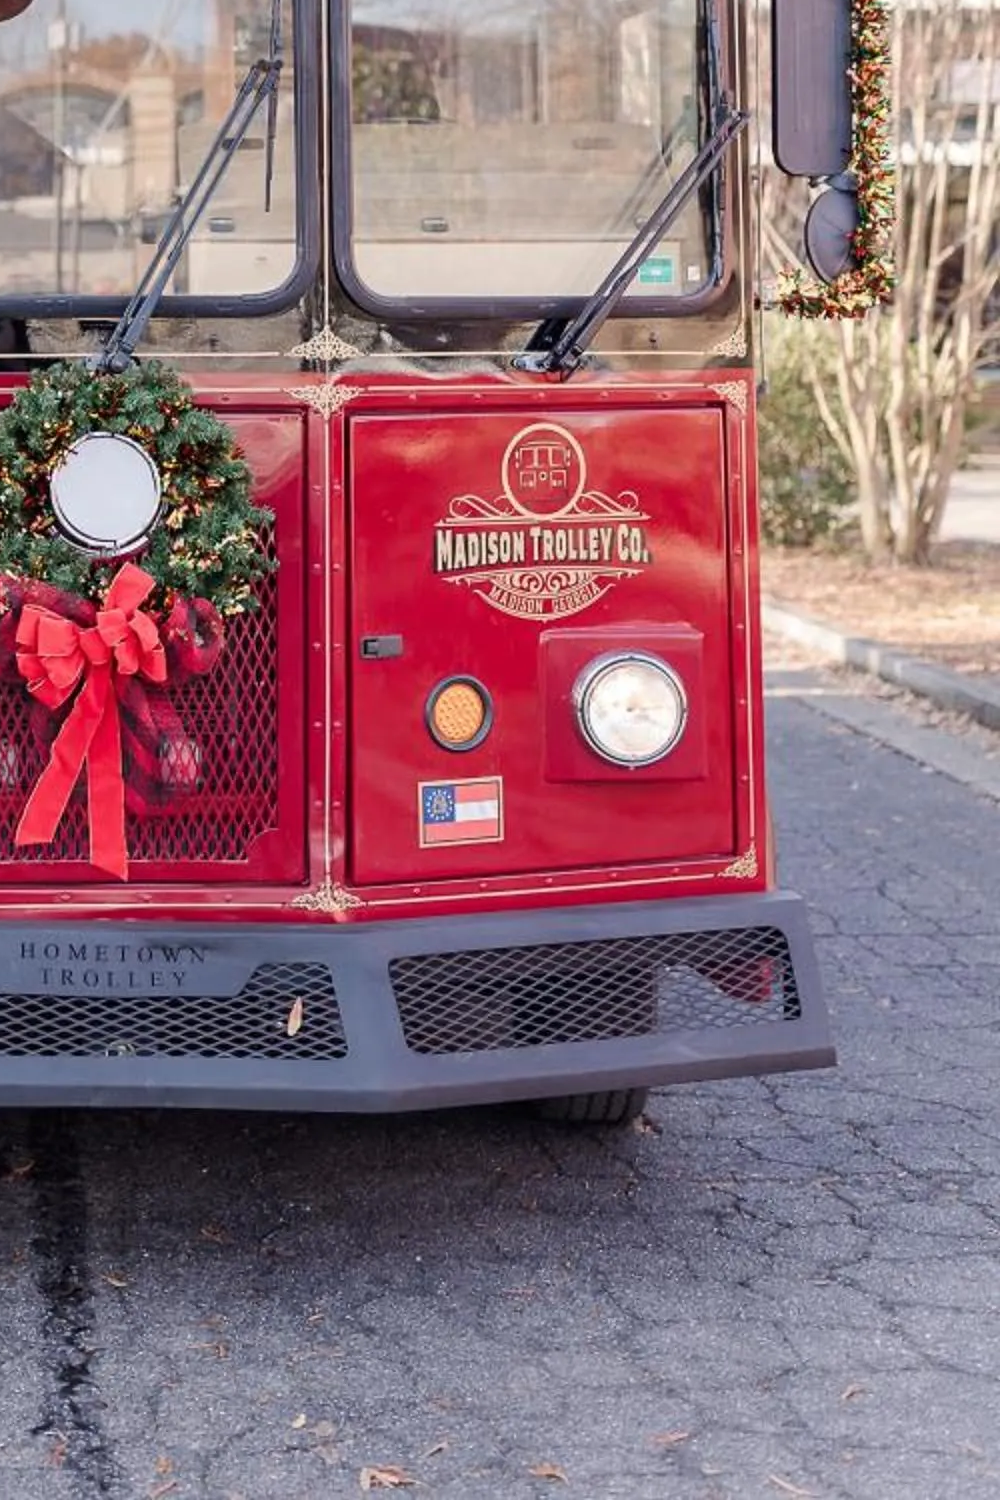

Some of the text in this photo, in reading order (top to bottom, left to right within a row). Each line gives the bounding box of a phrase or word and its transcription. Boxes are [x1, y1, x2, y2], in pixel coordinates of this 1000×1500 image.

[435, 523, 651, 572] MADISON TROLLEY CO.
[20, 941, 206, 964] HOMETOWN
[41, 967, 186, 989] TROLLEY
